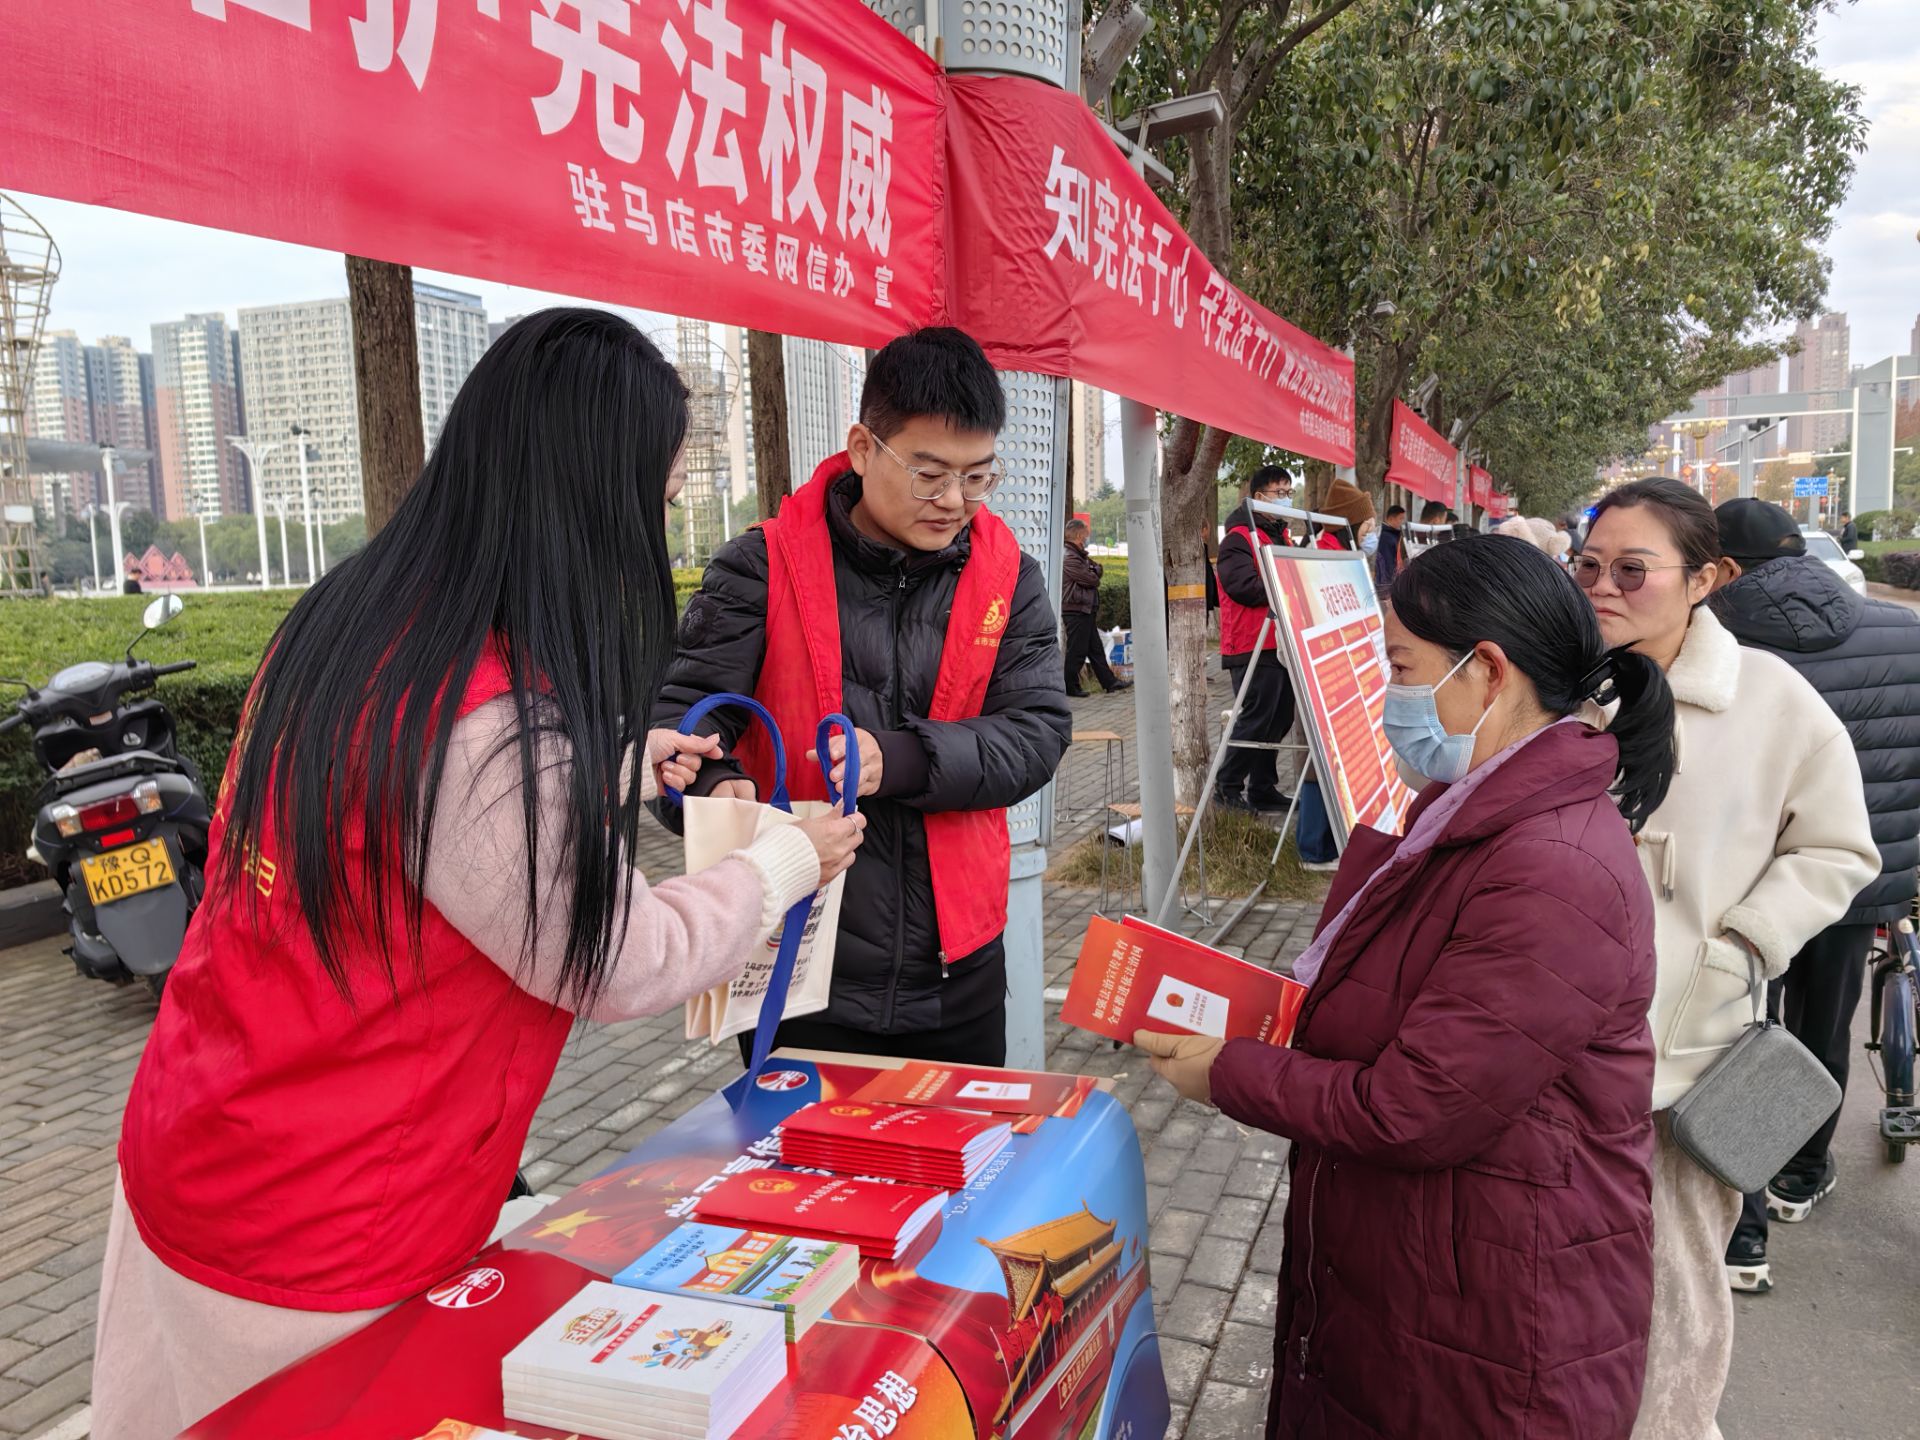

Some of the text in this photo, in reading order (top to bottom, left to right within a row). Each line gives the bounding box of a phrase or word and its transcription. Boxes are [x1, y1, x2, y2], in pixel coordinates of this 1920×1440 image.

[567, 163, 894, 309] 驻马店市委网信办 宣
[1043, 146, 1189, 328] 知宪法于心
[93, 861, 169, 900] KD572
[1092, 938, 1129, 1020] 加强法治宣传教育
[1107, 945, 1144, 1026] 全面推进依法治国
